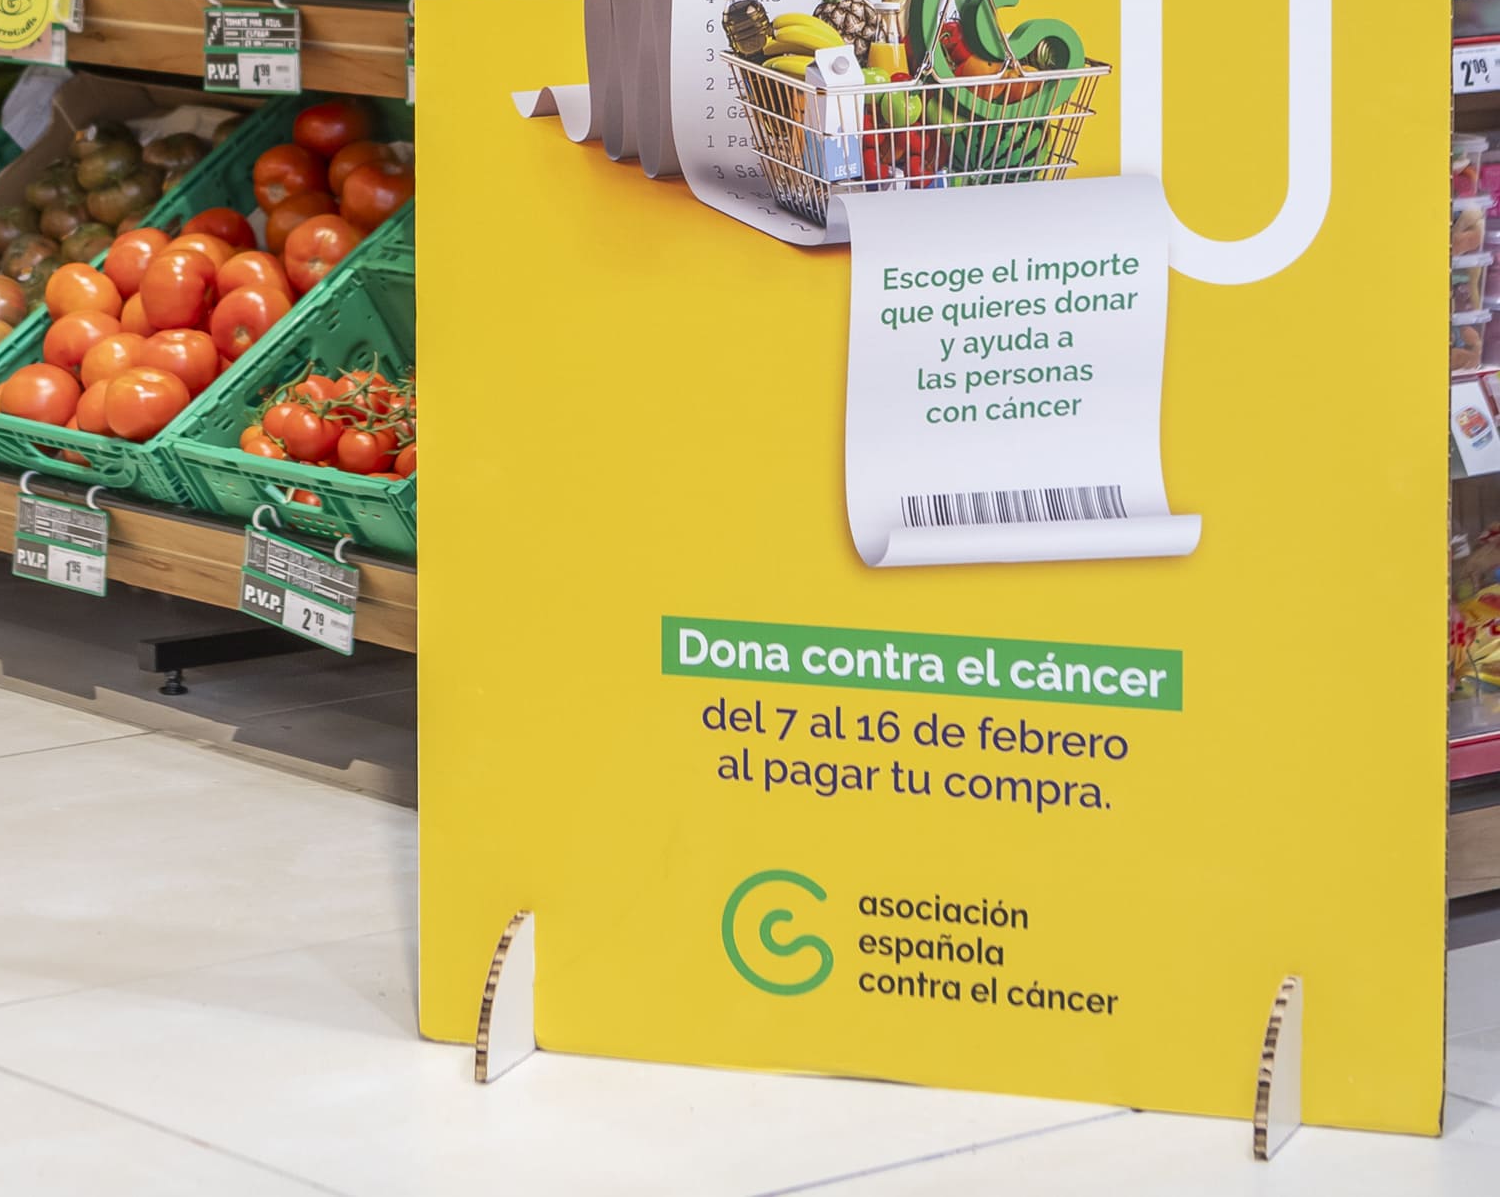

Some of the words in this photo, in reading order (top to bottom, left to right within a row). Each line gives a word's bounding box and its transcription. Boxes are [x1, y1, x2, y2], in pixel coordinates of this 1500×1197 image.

[705, 19, 715, 34] 6
[705, 47, 715, 62] 3
[207, 63, 239, 80] P.V.P.
[705, 76, 715, 91] 2
[705, 105, 716, 120] 2
[705, 134, 715, 149] 1
[713, 165, 725, 180] 3
[883, 267, 984, 293] Escoge
[992, 258, 1019, 284] el
[1027, 253, 1139, 286] importe
[880, 305, 934, 330] que
[941, 295, 1046, 326] quieres
[1054, 289, 1139, 314] donar
[940, 337, 956, 361] y
[963, 326, 1049, 359] ayuda
[1057, 330, 1074, 348] a
[917, 368, 957, 391] las
[965, 364, 1093, 394] personas
[926, 404, 977, 424] con
[984, 396, 1082, 422] cáncer
[16, 548, 47, 570] P.V.P.
[244, 584, 282, 613] P.V.P.
[679, 628, 790, 673] Dona
[801, 642, 945, 684] contra
[956, 648, 1001, 687] el
[1009, 652, 1167, 698] cáncer
[702, 697, 766, 734] del
[775, 708, 798, 741] 7
[810, 706, 846, 740] al
[856, 710, 901, 743] 16
[913, 712, 966, 748] de
[977, 716, 1129, 761] febrero
[717, 749, 754, 782] al
[764, 758, 880, 797] pagar
[890, 760, 931, 796] tu
[944, 772, 1111, 814] compra.
[858, 894, 1028, 930] asociación
[858, 934, 1004, 966] española
[858, 971, 961, 1001] contra
[970, 977, 997, 1004] el
[1007, 980, 1119, 1015] cáncer
